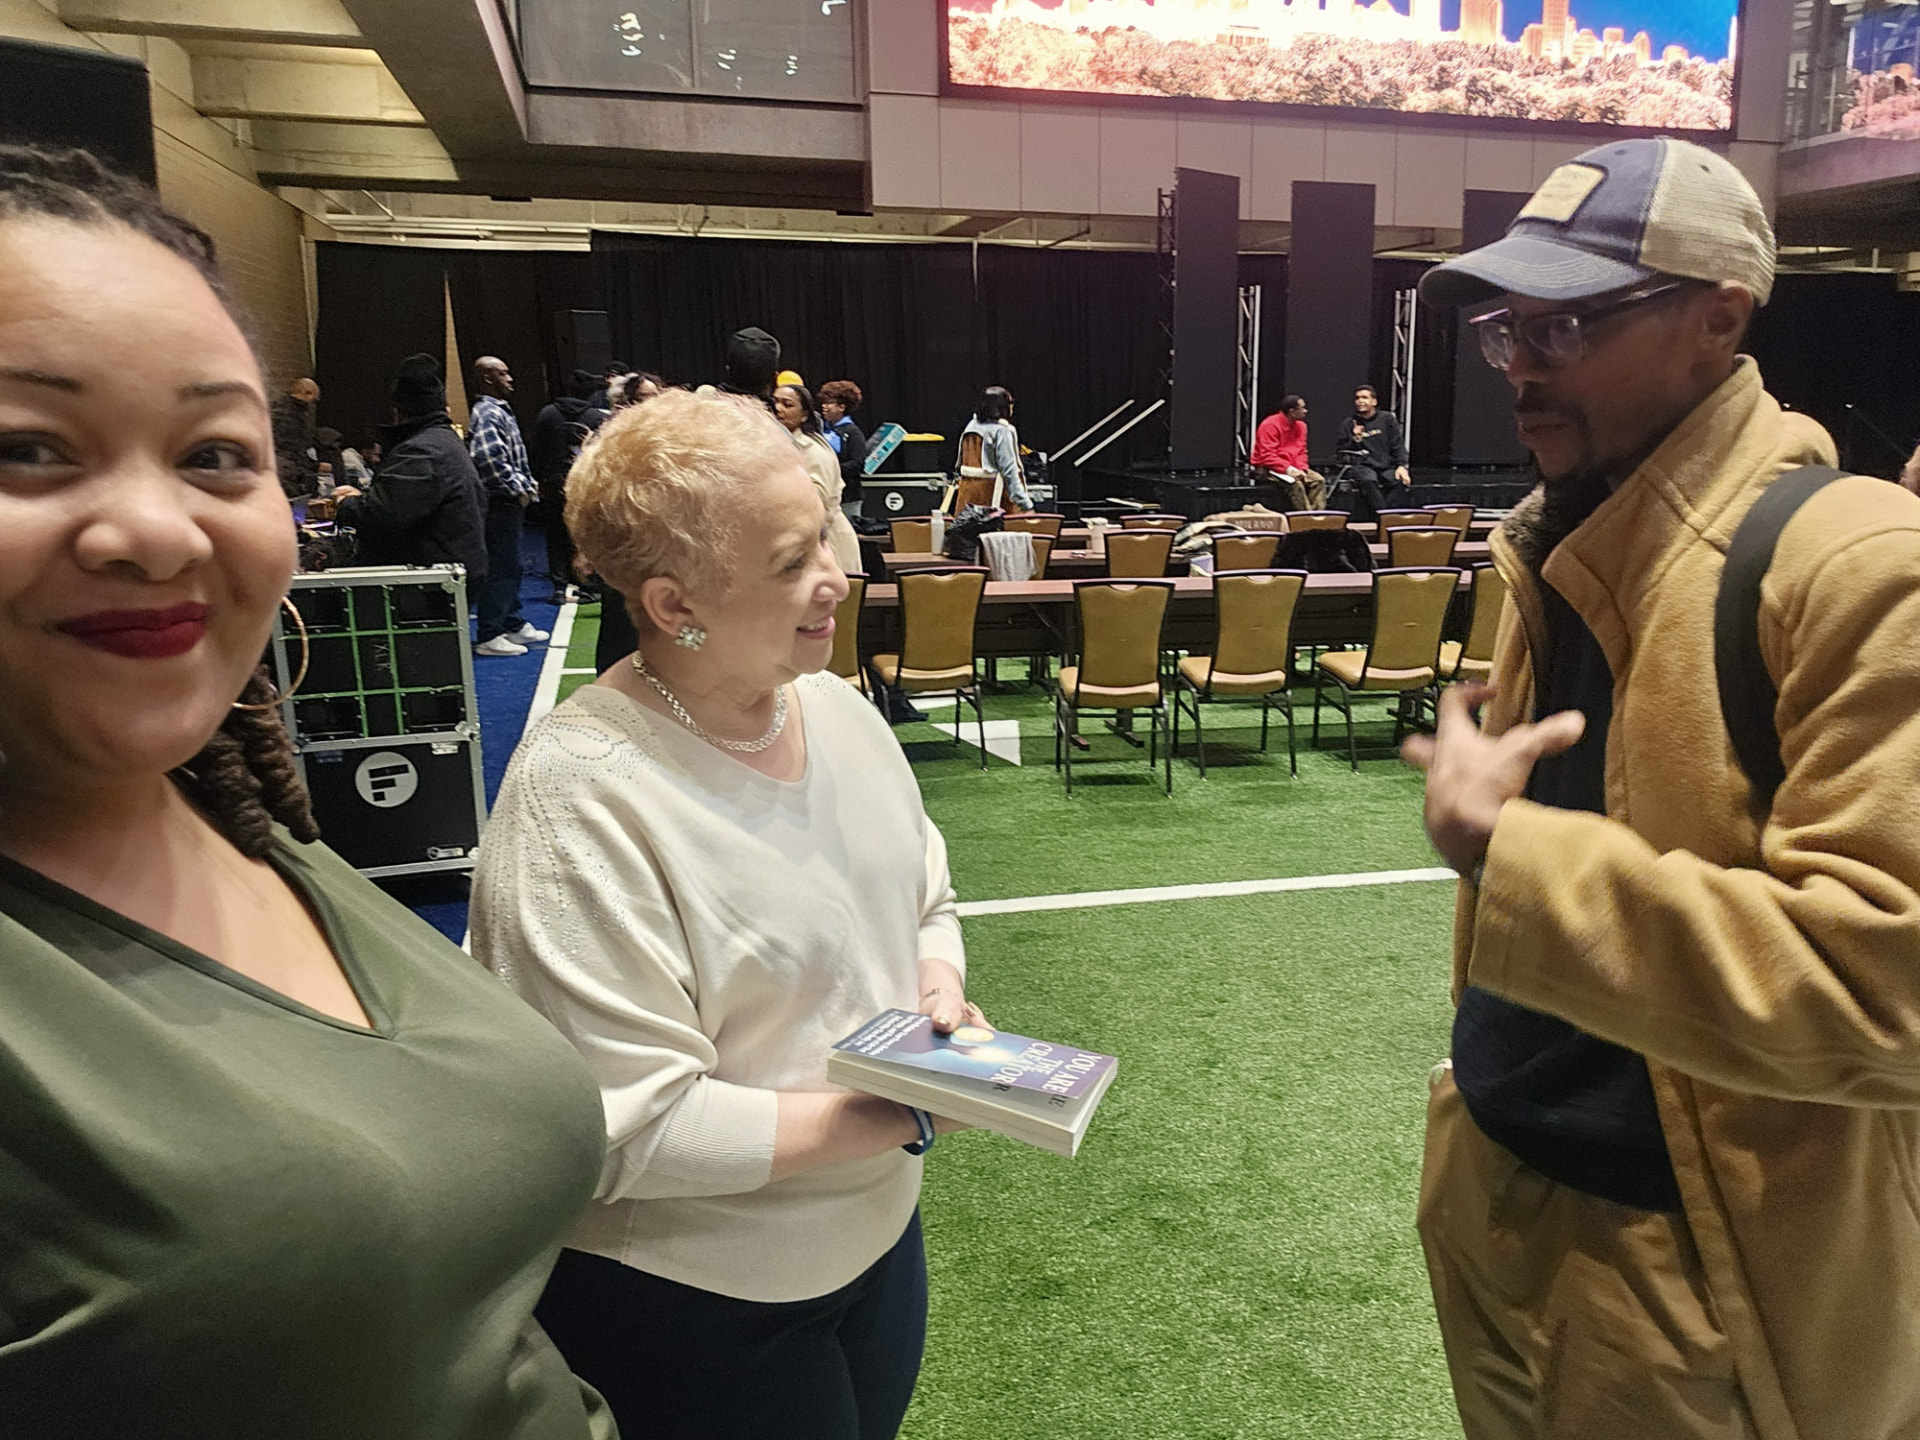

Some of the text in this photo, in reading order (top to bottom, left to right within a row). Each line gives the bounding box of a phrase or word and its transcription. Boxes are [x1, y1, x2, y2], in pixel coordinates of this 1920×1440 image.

[990, 1042, 1053, 1084] CREATOR
[1030, 1059, 1064, 1075] THE
[1041, 1053, 1103, 1093] YOU ARE
